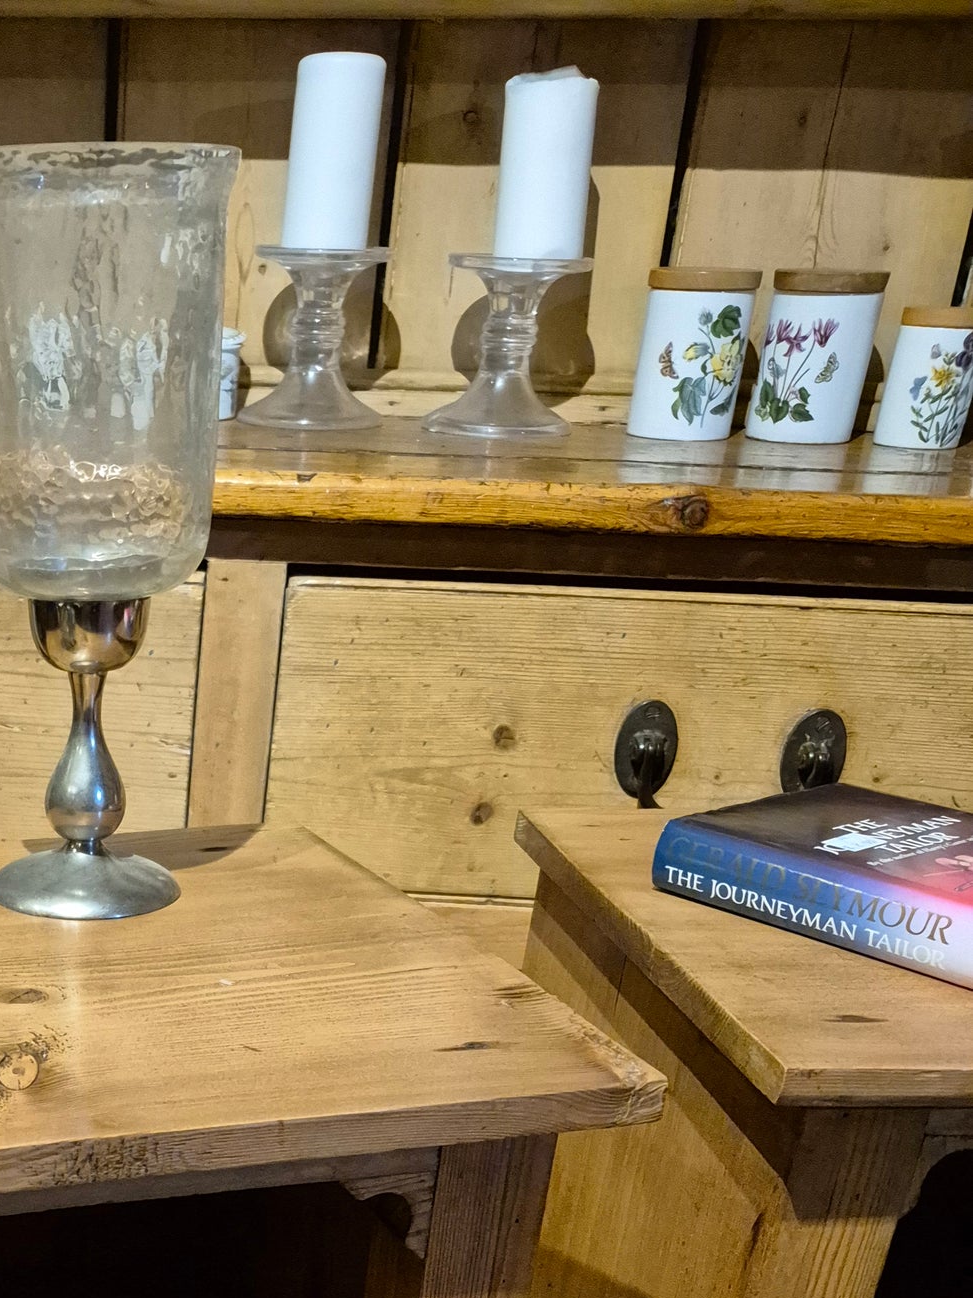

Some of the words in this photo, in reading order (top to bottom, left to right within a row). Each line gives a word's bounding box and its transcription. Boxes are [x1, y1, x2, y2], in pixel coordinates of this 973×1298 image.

[832, 818, 888, 833] THE
[874, 831, 960, 854] TAILOR
[665, 865, 704, 893] THE
[710, 879, 858, 941] JOURNEYMAN
[864, 928, 946, 970] TAILOR
